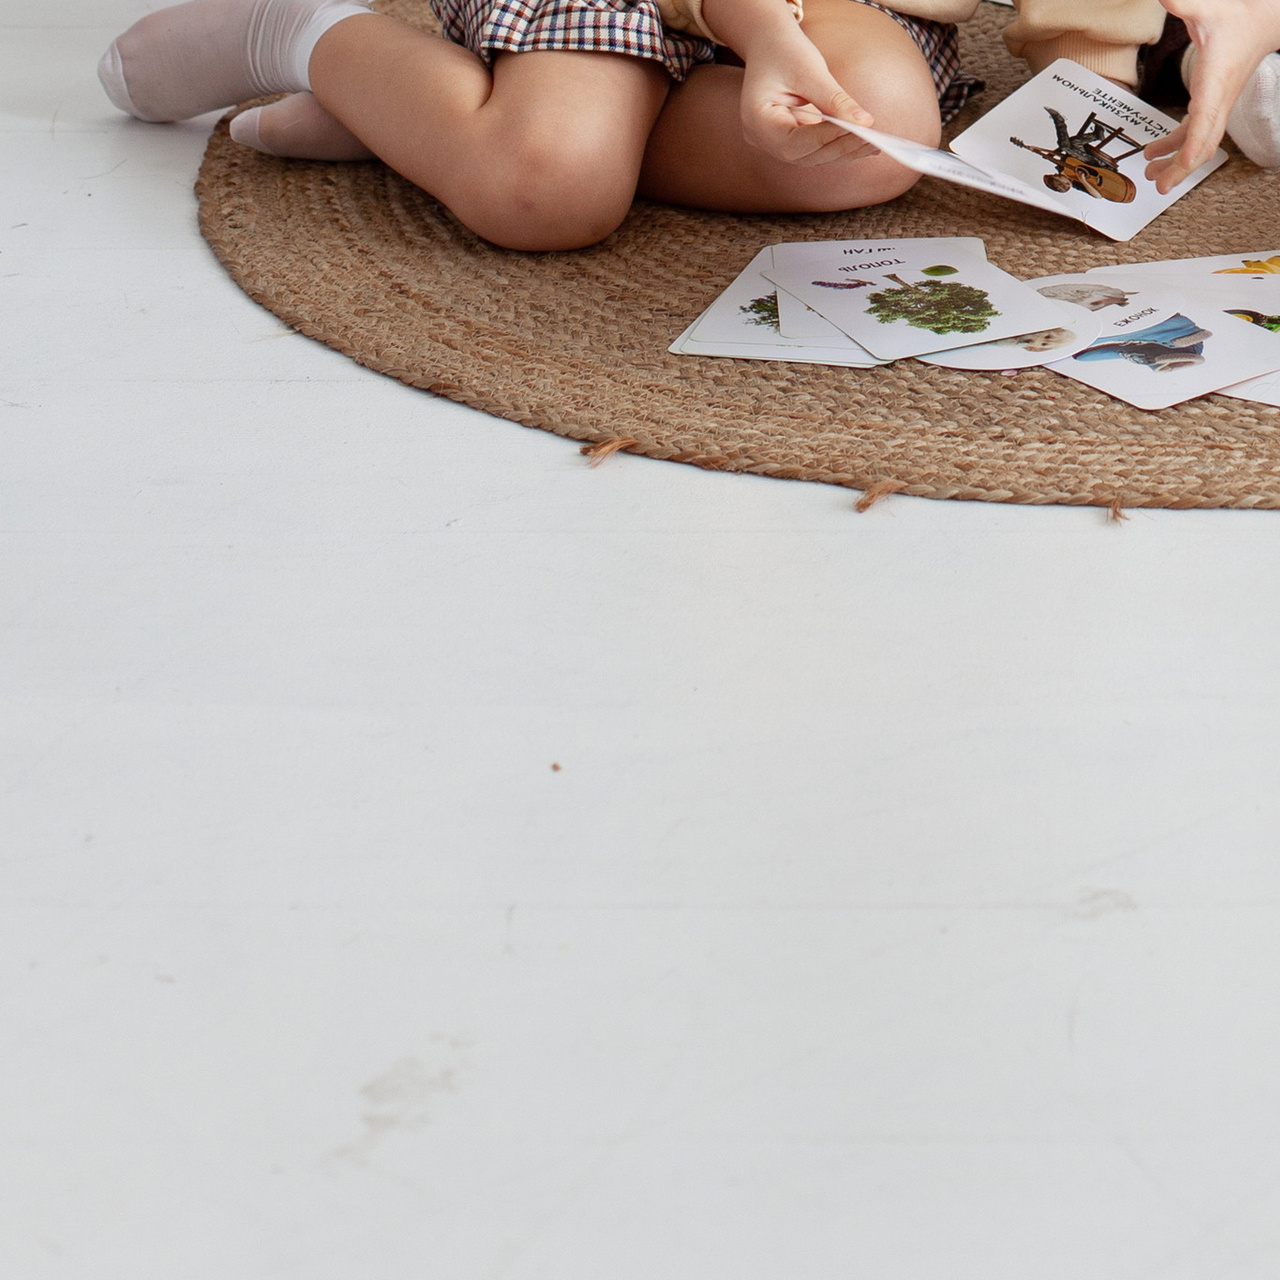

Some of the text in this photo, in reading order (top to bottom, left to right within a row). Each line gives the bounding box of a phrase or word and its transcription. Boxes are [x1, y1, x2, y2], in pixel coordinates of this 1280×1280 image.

[1052, 74, 1160, 138] НА МУЗЫКАЛЬНОМ
[1092, 87, 1171, 136] НСТРУМЕНТЕ
[838, 258, 906, 273] ТОПОЛЬ
[1113, 307, 1160, 328] ЕЖОНОК
